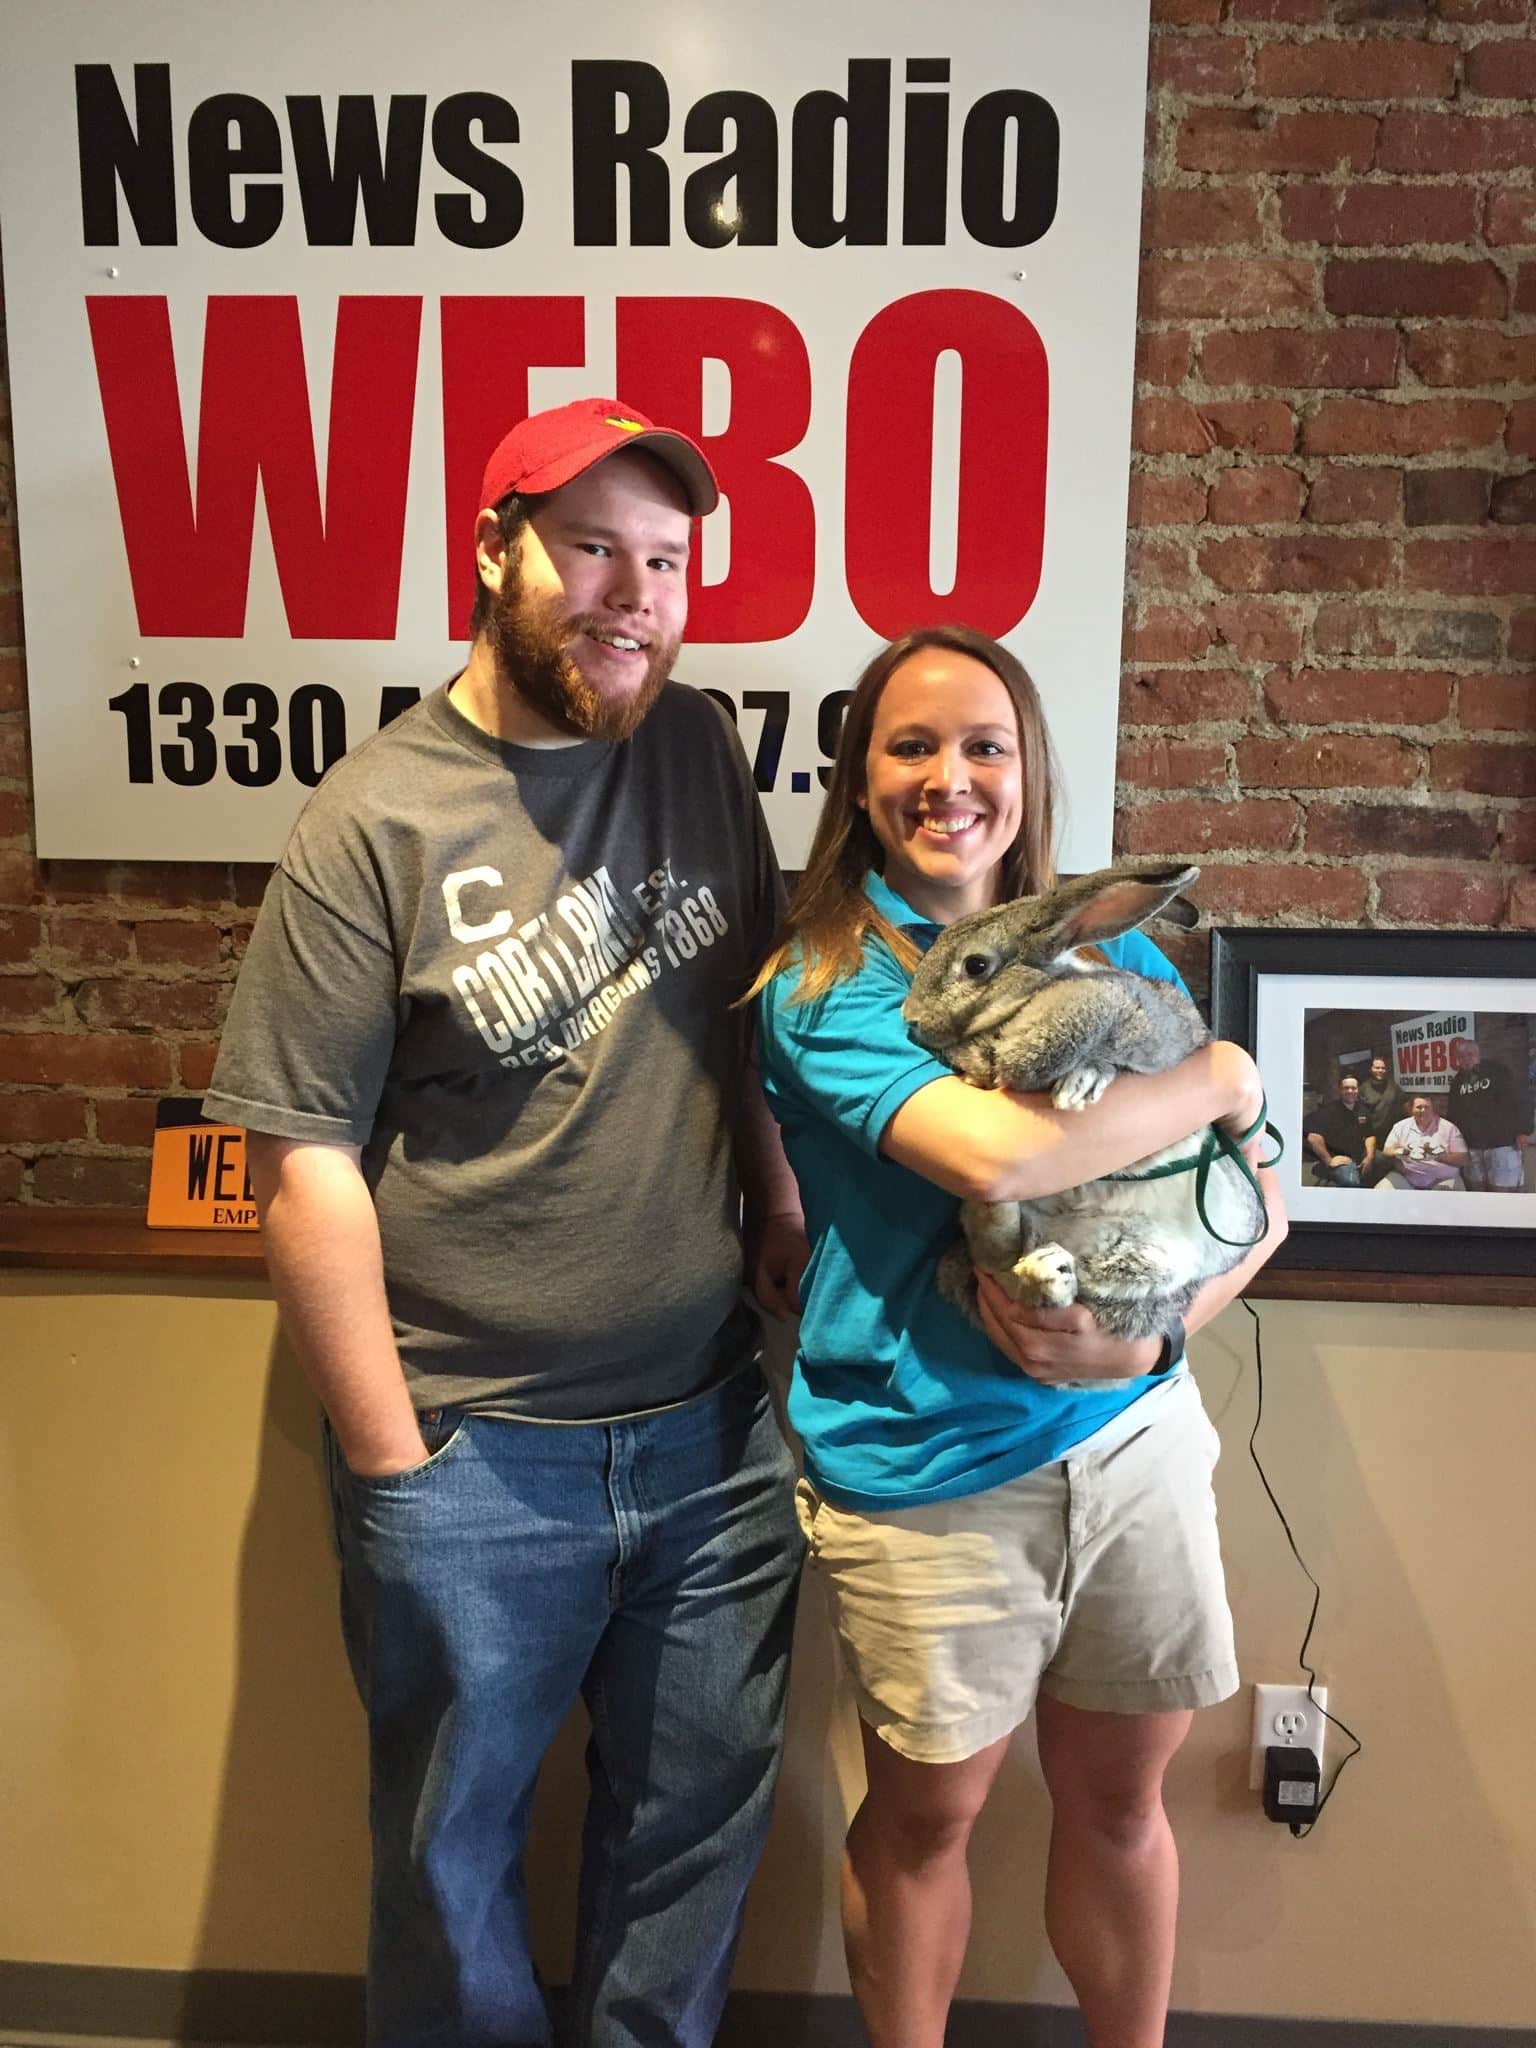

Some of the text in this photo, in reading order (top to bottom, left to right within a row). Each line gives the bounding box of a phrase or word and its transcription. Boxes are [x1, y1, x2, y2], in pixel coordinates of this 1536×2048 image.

[75, 58, 1060, 250] News Radio
[108, 682, 347, 788] 1330
[442, 865, 514, 944] C
[653, 886, 729, 969] 1868
[560, 946, 662, 1051] DRAGONS
[1395, 1016, 1467, 1044] News Radio
[213, 1207, 256, 1224] EMP
